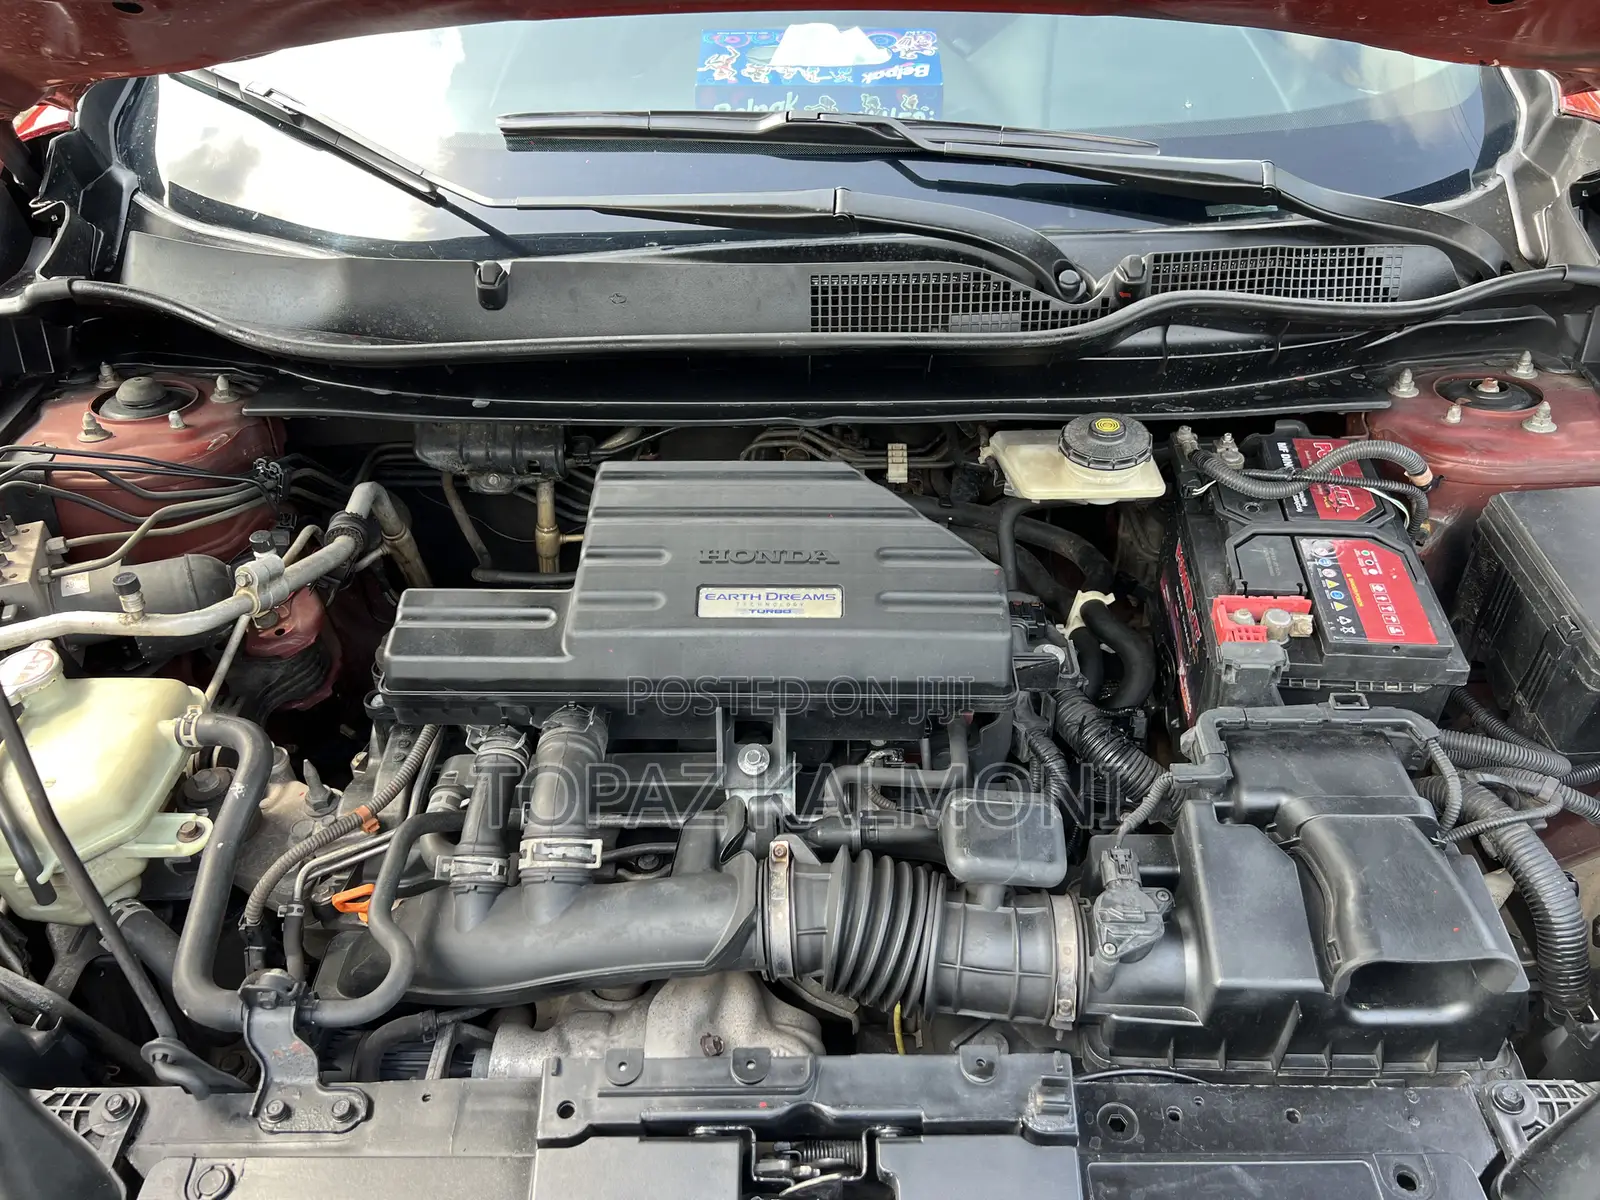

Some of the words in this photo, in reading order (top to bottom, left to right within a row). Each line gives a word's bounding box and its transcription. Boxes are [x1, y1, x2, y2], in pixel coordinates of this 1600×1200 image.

[861, 63, 930, 84] Belpak
[699, 549, 840, 565] HONDA
[705, 593, 762, 601] EARTH
[765, 592, 836, 601] DREAMS
